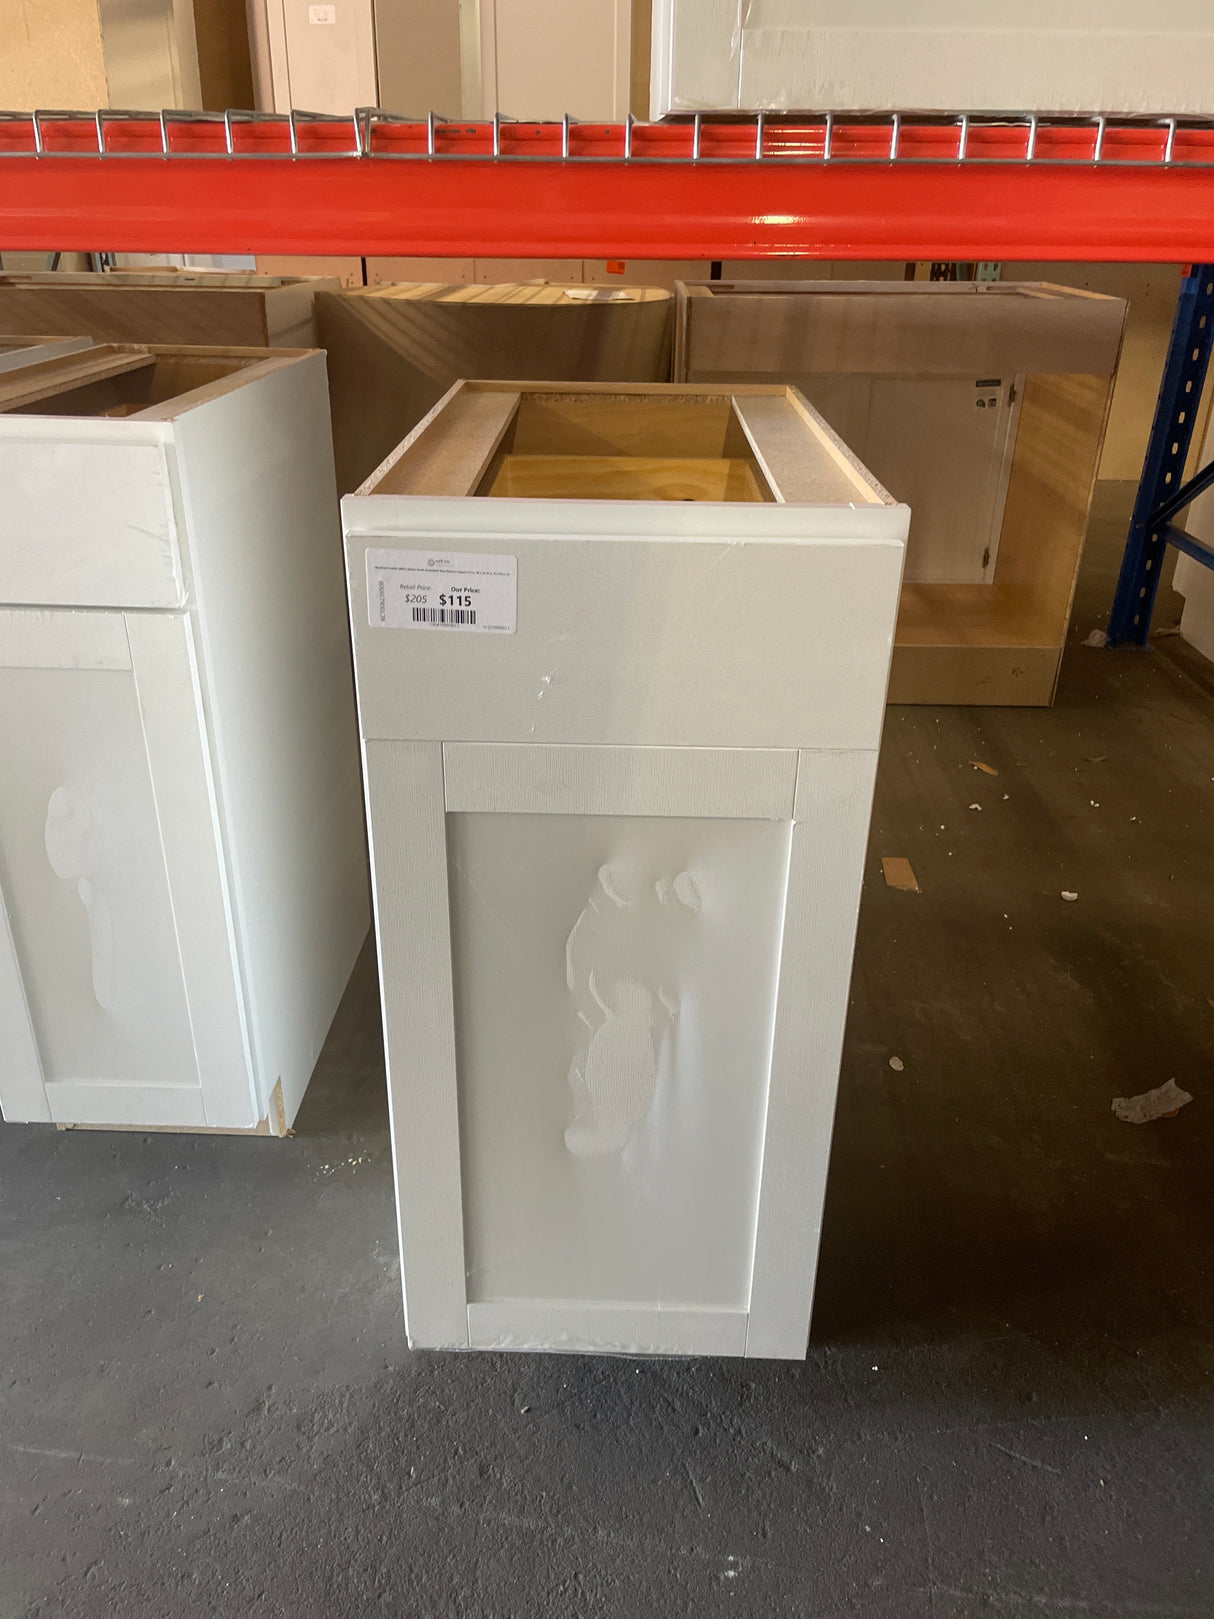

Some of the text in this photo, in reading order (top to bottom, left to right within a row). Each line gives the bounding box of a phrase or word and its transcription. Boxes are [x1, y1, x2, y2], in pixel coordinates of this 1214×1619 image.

[399, 583, 432, 592] Retail Price:
[404, 593, 428, 604] $205
[439, 593, 472, 607] $115
